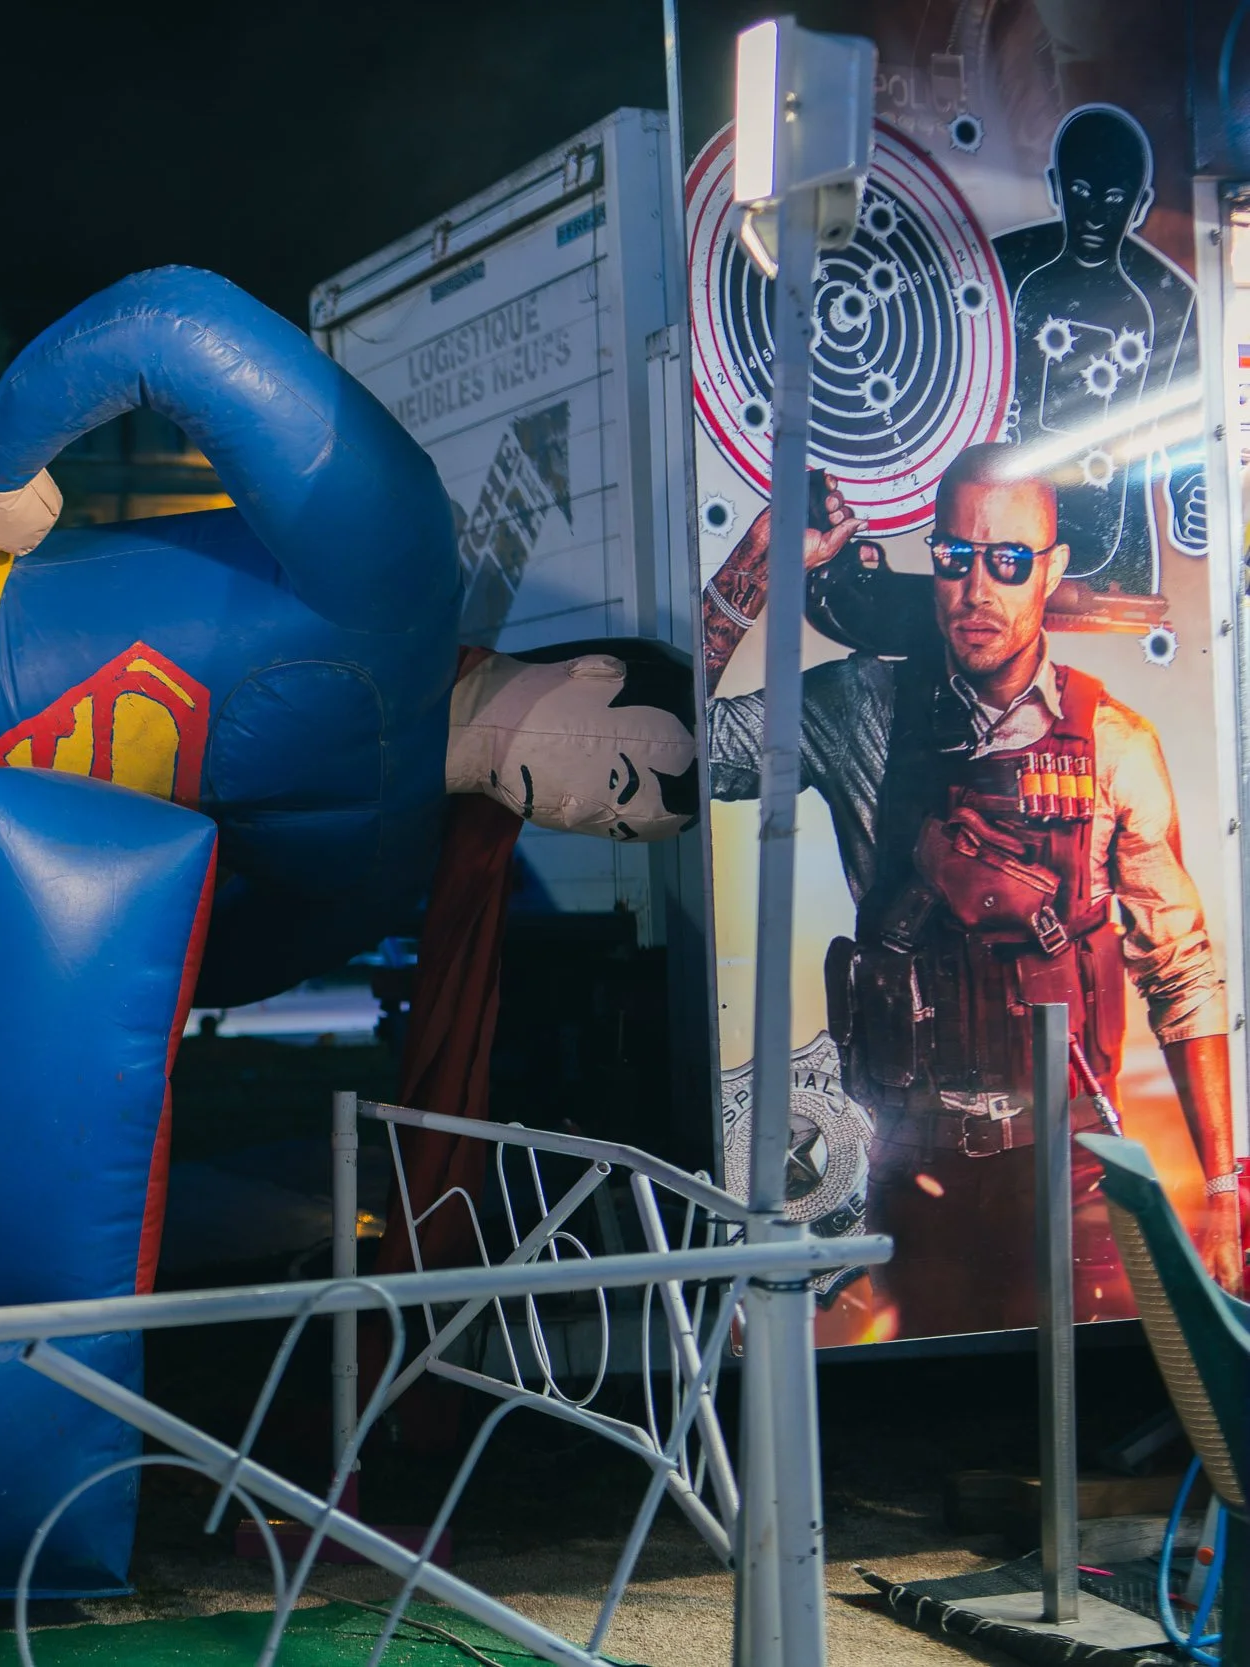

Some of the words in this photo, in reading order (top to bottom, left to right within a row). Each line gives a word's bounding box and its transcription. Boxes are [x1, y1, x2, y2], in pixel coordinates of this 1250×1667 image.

[956, 250, 967, 263] 2
[407, 294, 540, 389] LOGISTIQUE
[491, 328, 572, 394] NEUFS
[702, 380, 710, 393] 1
[717, 372, 727, 385] 2
[748, 356, 757, 369] 4
[762, 348, 772, 362] 5
[893, 431, 903, 446] 4
[911, 473, 921, 486] 2
[723, 1071, 837, 1123] SPIAL
